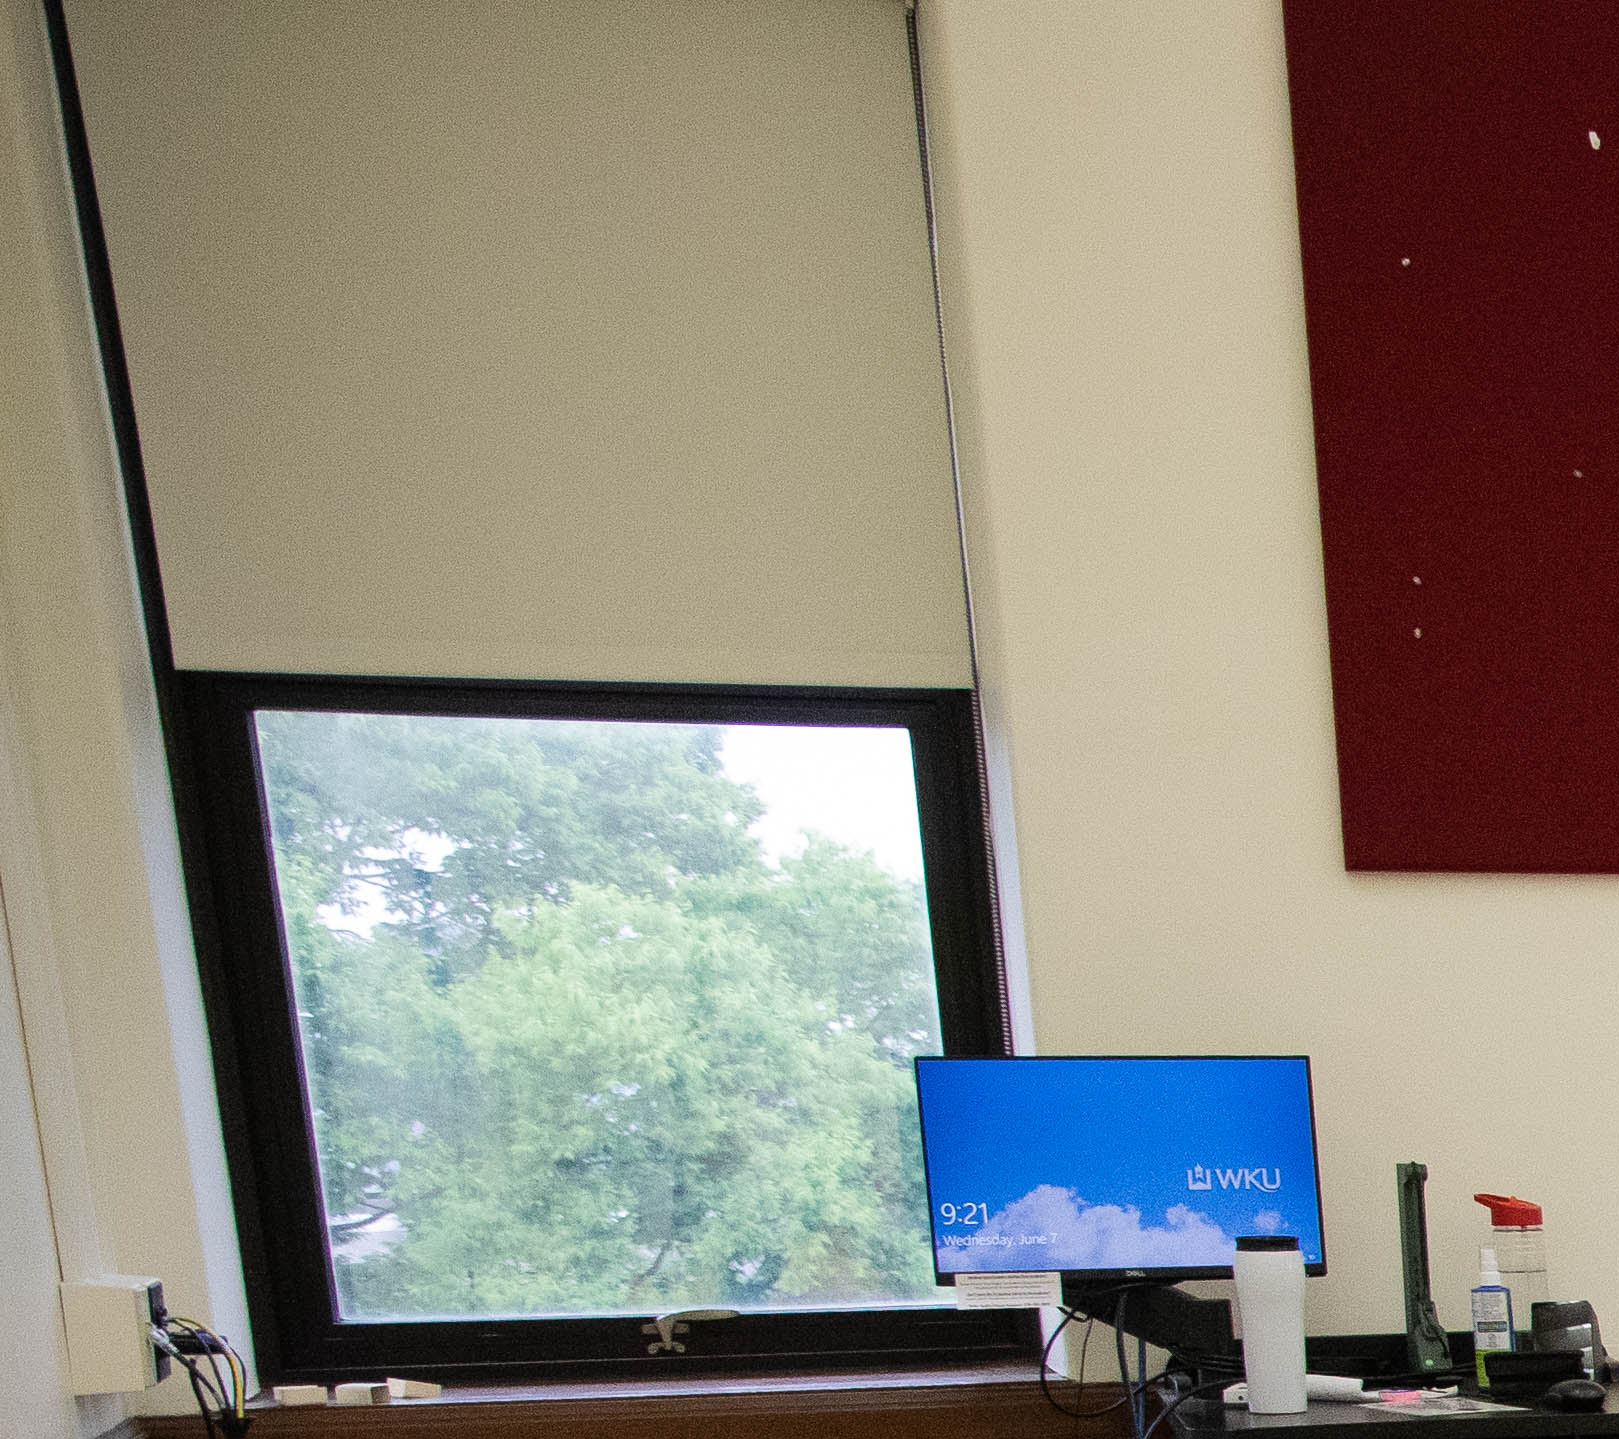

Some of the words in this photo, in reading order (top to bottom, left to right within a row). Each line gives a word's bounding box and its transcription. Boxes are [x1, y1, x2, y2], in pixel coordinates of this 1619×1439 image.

[1214, 1168, 1281, 1193] WKU
[941, 1202, 989, 1225] 9:21
[943, 1234, 1016, 1248] Wednesday,
[1019, 1234, 1048, 1245] June
[1050, 1232, 1059, 1244] 7
